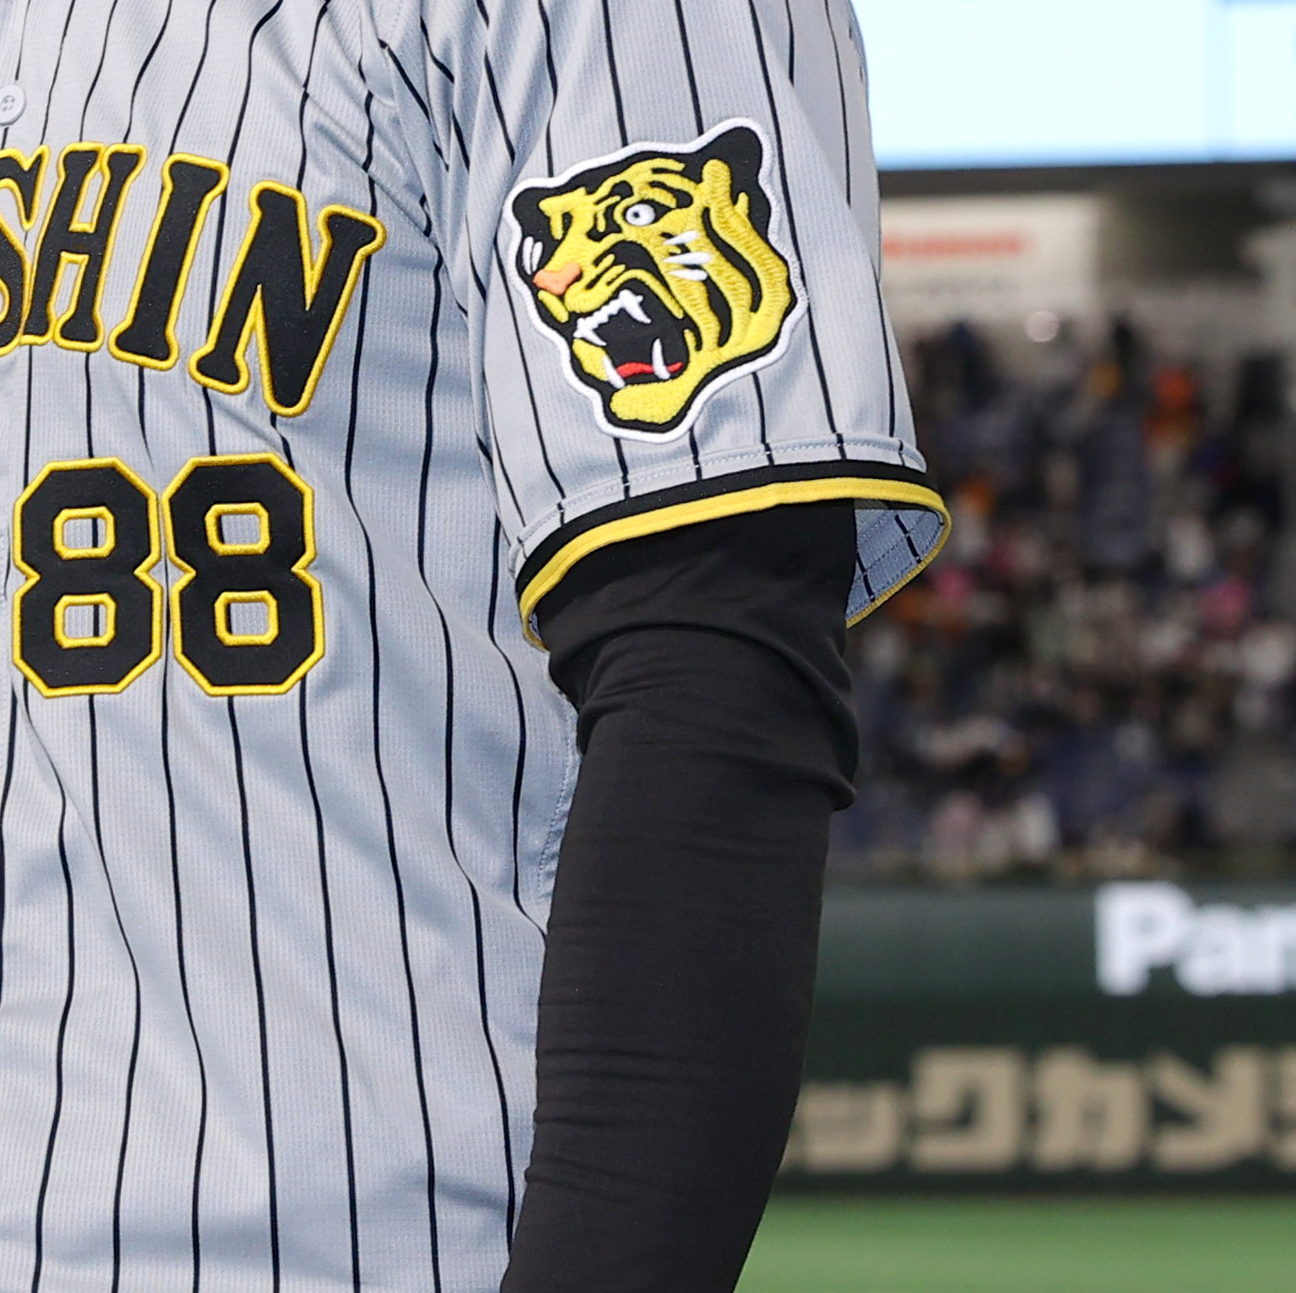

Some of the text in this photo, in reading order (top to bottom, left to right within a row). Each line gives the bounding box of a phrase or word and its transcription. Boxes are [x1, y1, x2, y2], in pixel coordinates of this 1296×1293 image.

[13, 452, 326, 698] 88
[781, 1044, 1296, 1175] ックカメ
